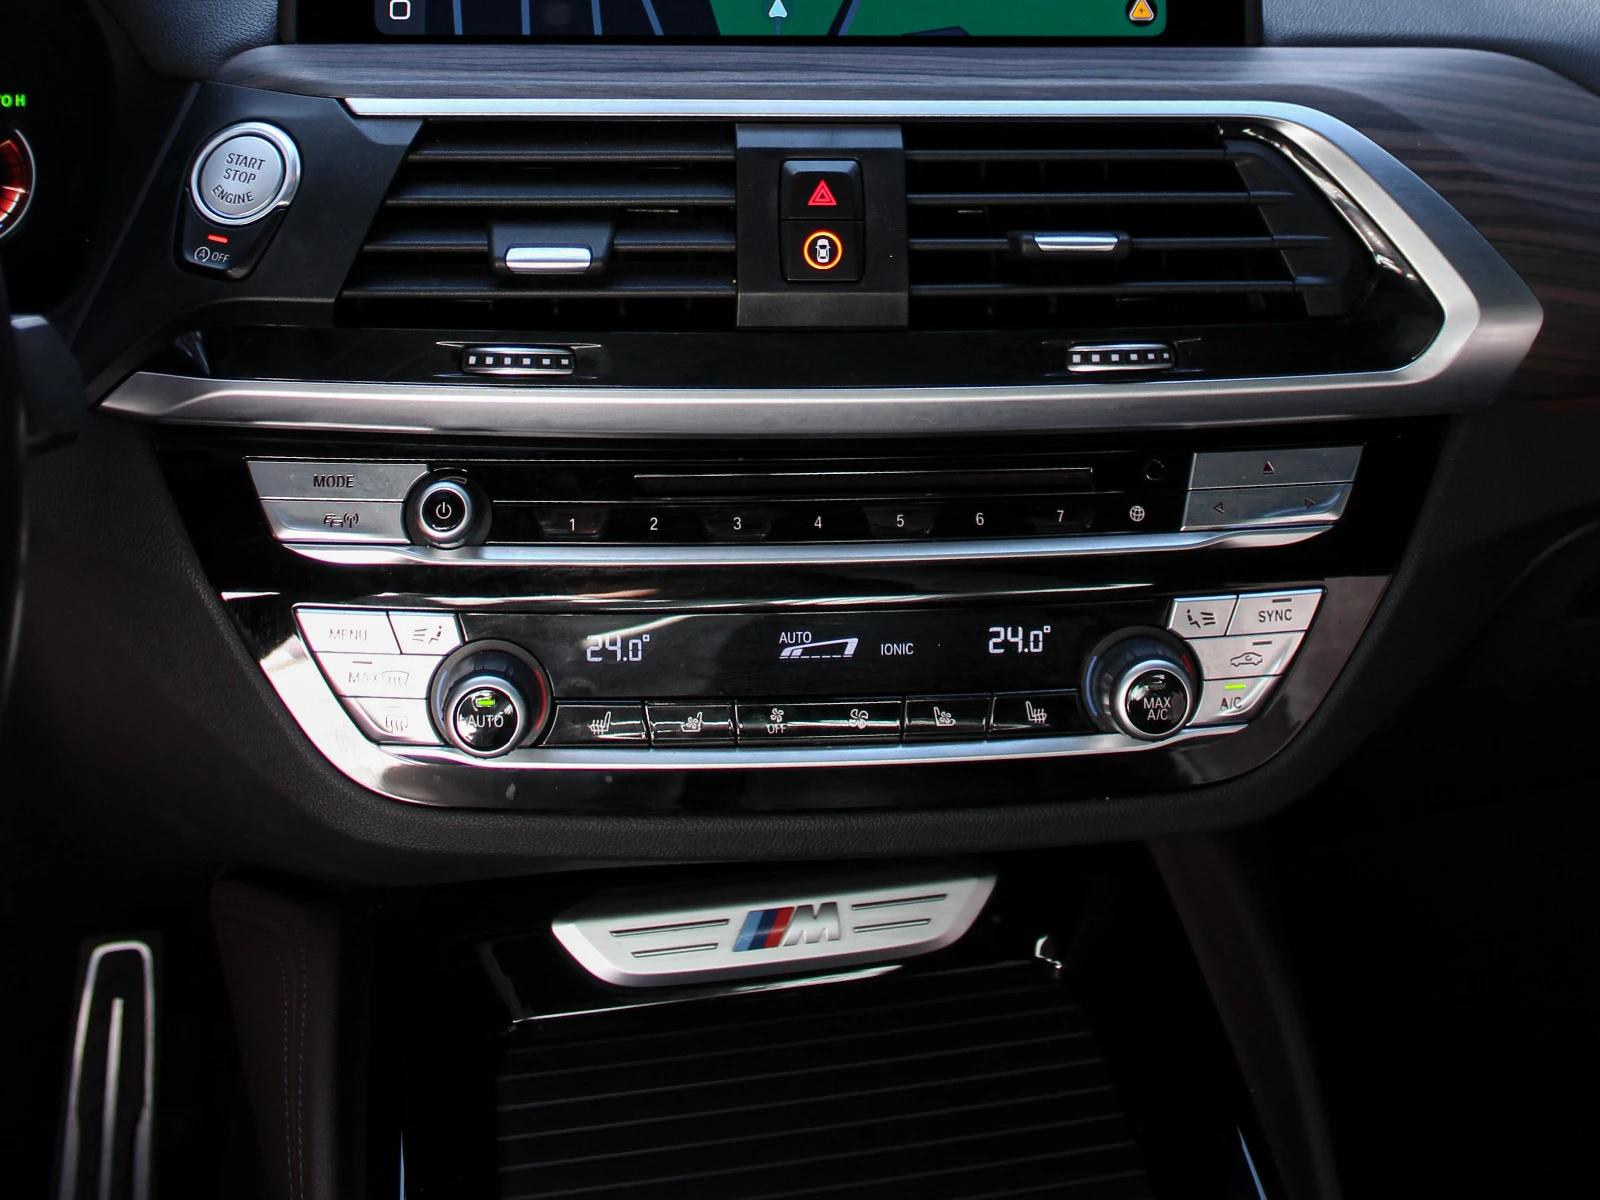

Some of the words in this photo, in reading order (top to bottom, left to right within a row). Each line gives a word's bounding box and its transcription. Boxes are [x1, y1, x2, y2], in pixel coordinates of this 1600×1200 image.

[226, 152, 266, 170] START
[223, 168, 256, 184] STOP
[212, 184, 254, 204] ENGINE
[212, 252, 230, 263] OFF
[313, 474, 354, 488] MODE
[814, 516, 822, 529] 4
[896, 514, 904, 528] 5
[976, 512, 985, 526] 6
[1057, 510, 1064, 523] 7
[570, 518, 575, 531] 1
[650, 517, 658, 530] 2
[733, 517, 742, 530] 3
[1258, 609, 1292, 622] SYNC
[779, 632, 812, 644] AUTO
[880, 644, 914, 656] IONIC
[1143, 697, 1171, 708] MAX
[1220, 696, 1242, 710] A/C
[467, 714, 504, 728] AUTO
[1147, 708, 1168, 721] A/C
[766, 724, 786, 734] OFF
